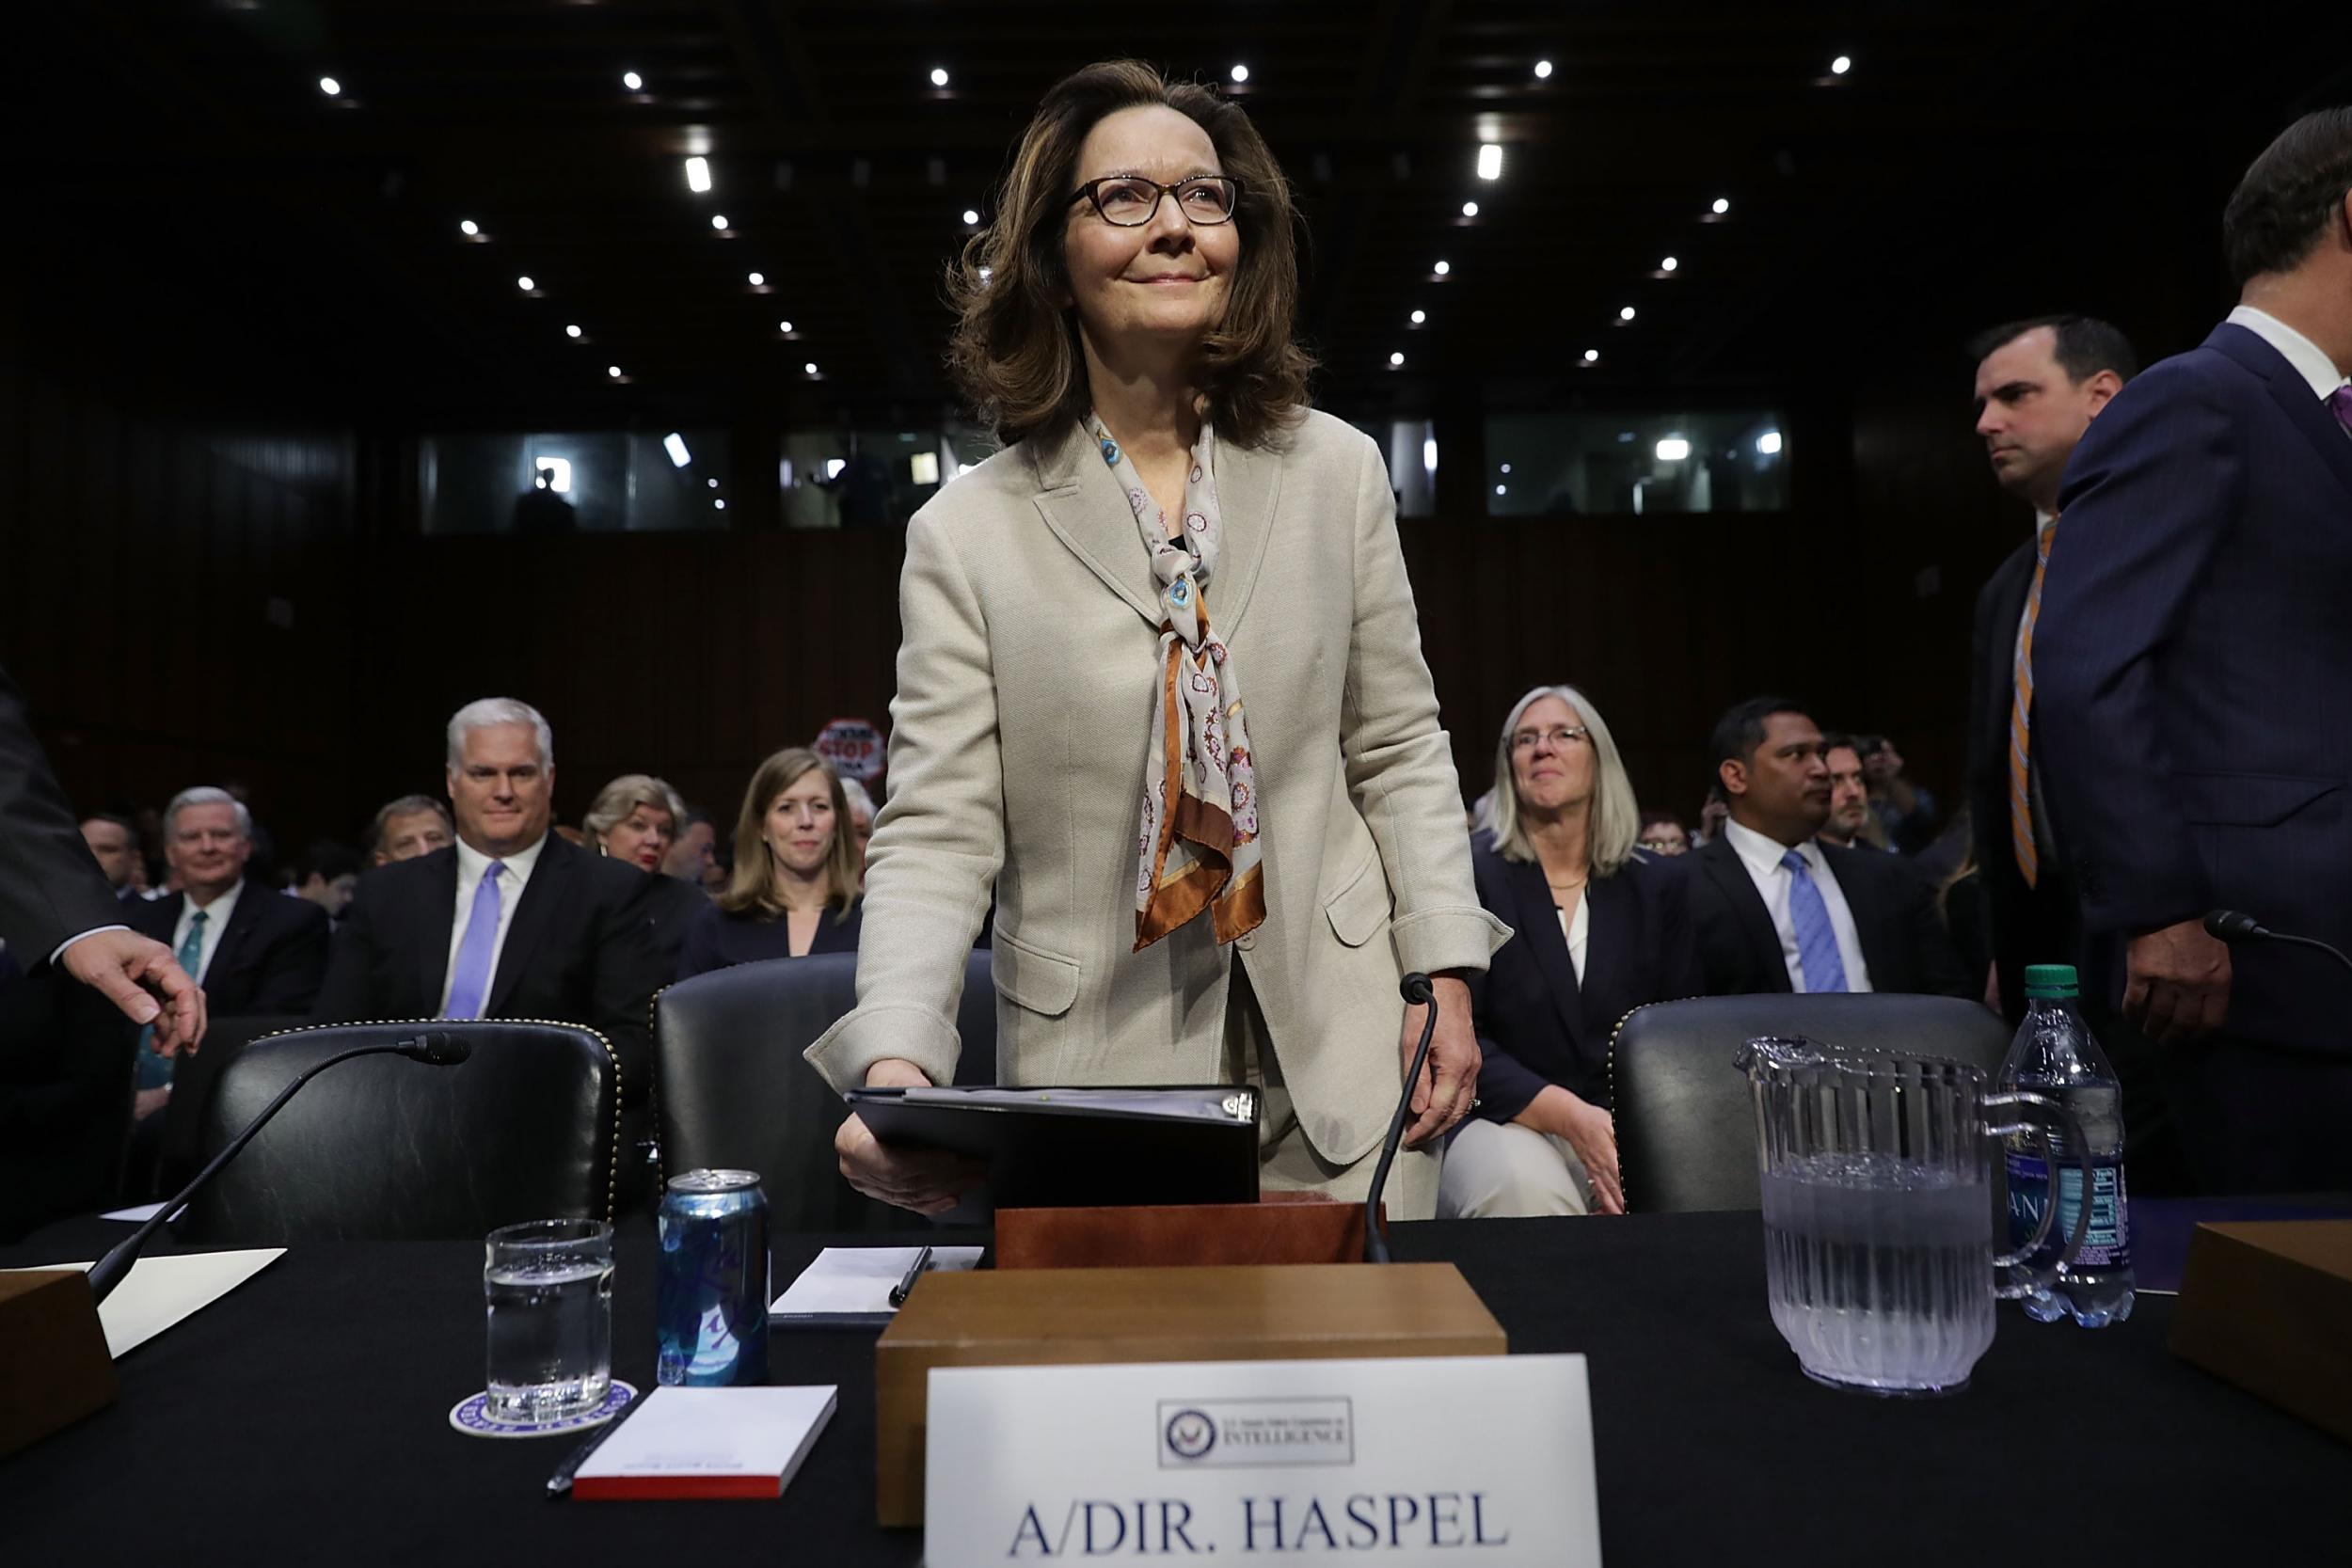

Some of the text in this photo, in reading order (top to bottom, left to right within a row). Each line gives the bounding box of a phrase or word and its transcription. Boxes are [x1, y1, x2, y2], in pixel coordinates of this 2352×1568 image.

[1223, 1429, 1344, 1446] INTELLIGENCE
[1006, 1492, 1509, 1558] A/DIR. HASPEL
